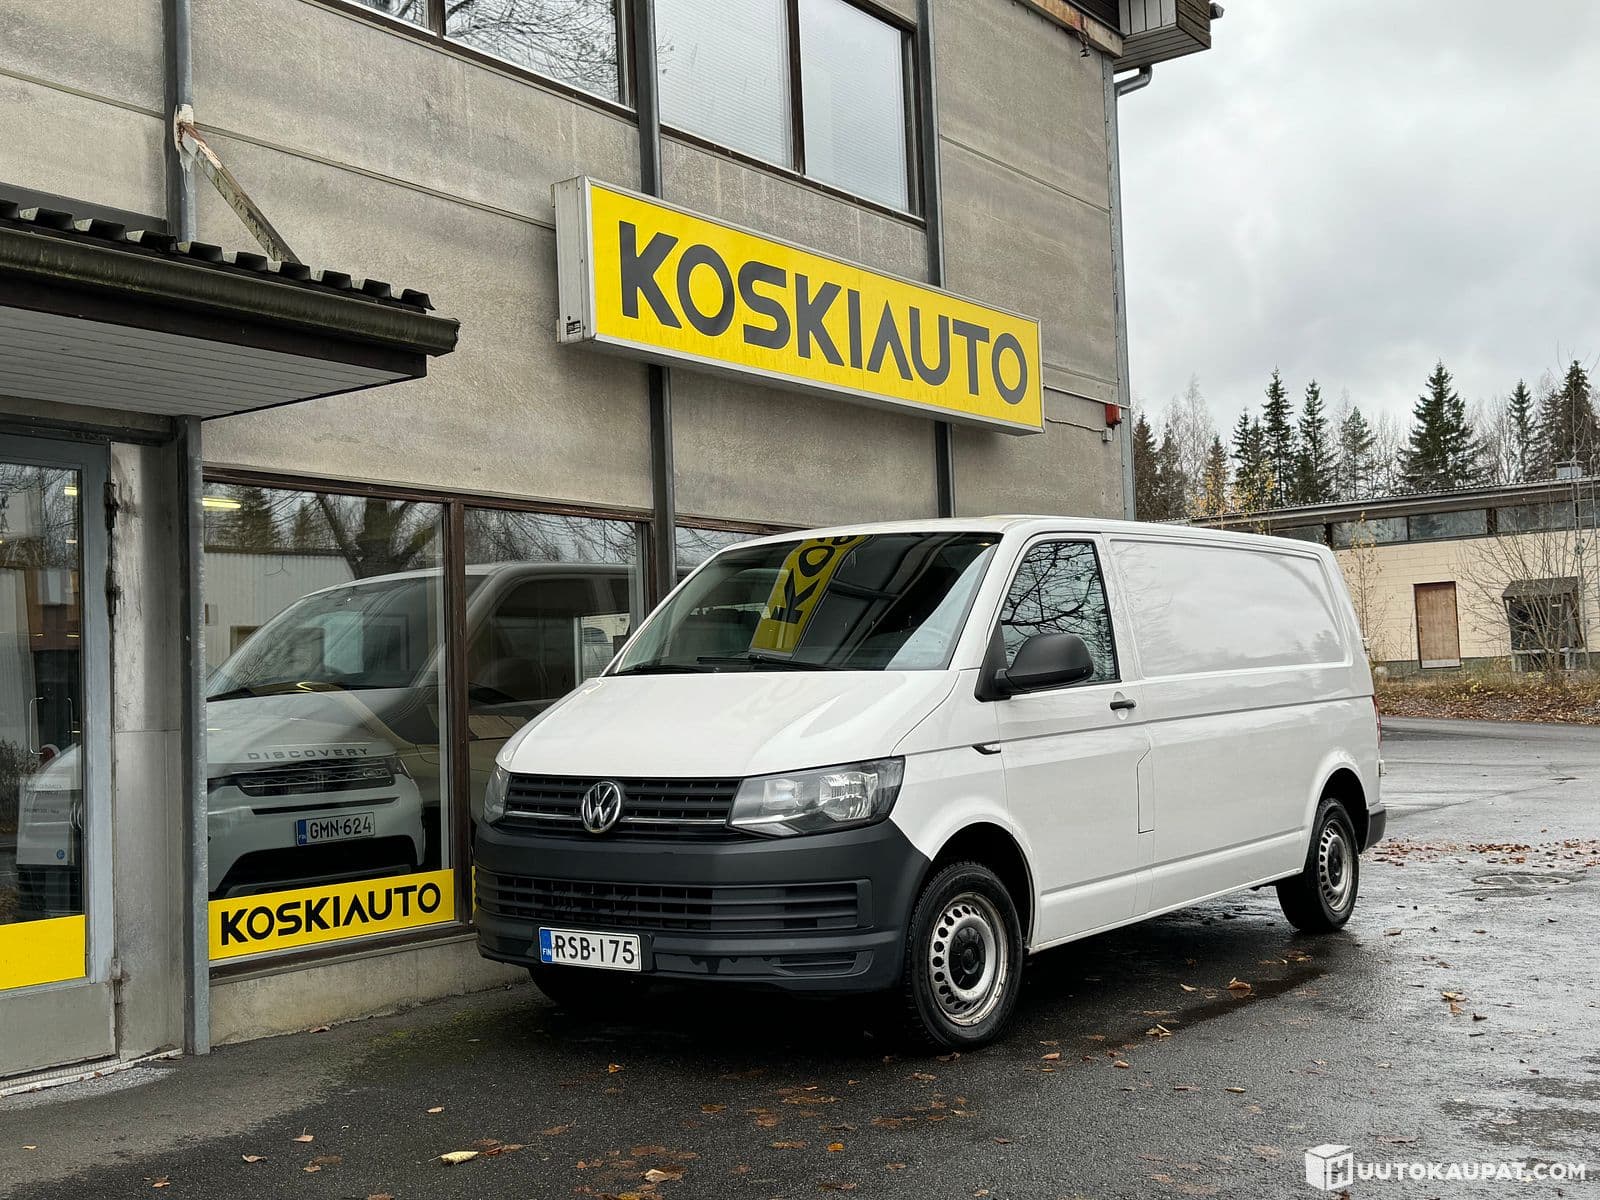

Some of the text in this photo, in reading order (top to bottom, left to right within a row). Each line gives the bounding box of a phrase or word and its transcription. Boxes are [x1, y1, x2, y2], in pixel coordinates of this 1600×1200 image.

[618, 220, 1028, 405] KOSKIAUTO
[247, 748, 369, 760] DISCOVERY
[221, 882, 441, 946] KOSKIAUTO
